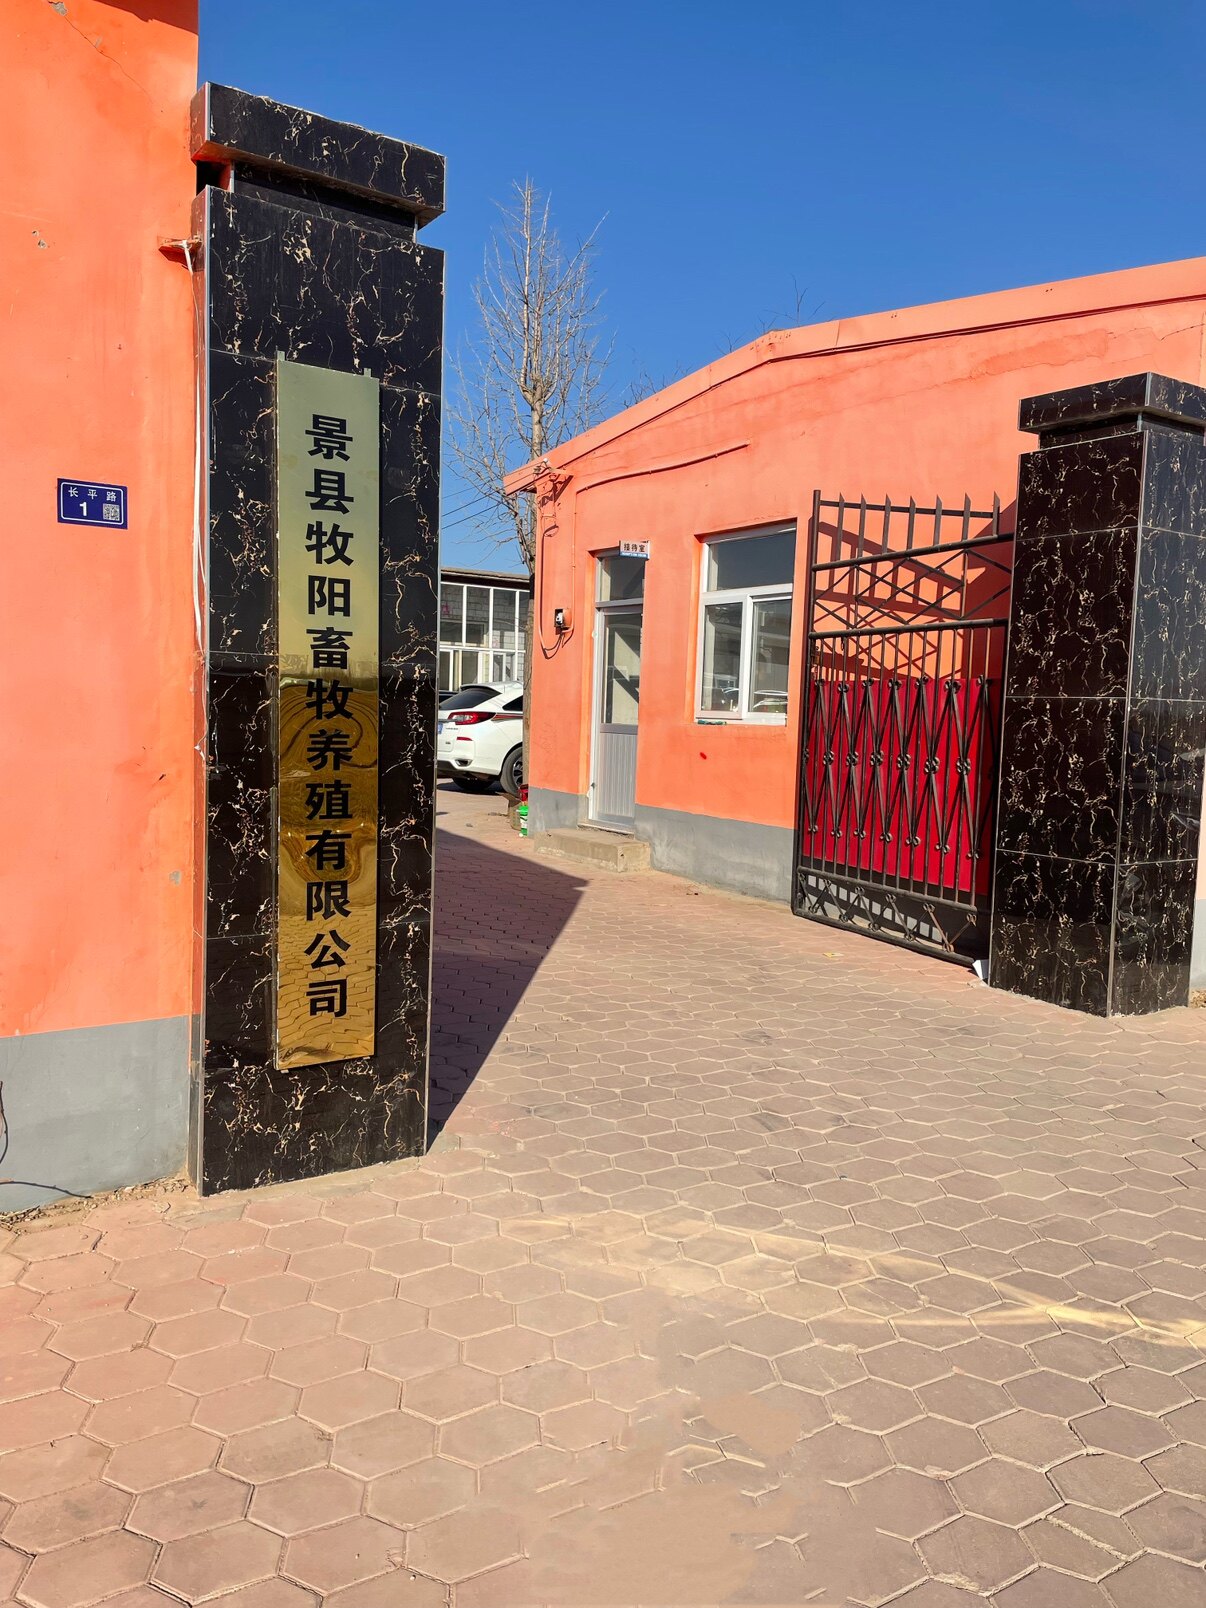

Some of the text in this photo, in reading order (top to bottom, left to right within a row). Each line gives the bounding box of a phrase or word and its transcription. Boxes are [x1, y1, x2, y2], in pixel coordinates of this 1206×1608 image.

[68, 486, 117, 502] 长平路
[79, 501, 87, 517] 1
[304, 413, 354, 1018] 景县牧阳畜牧养殖有限公司
